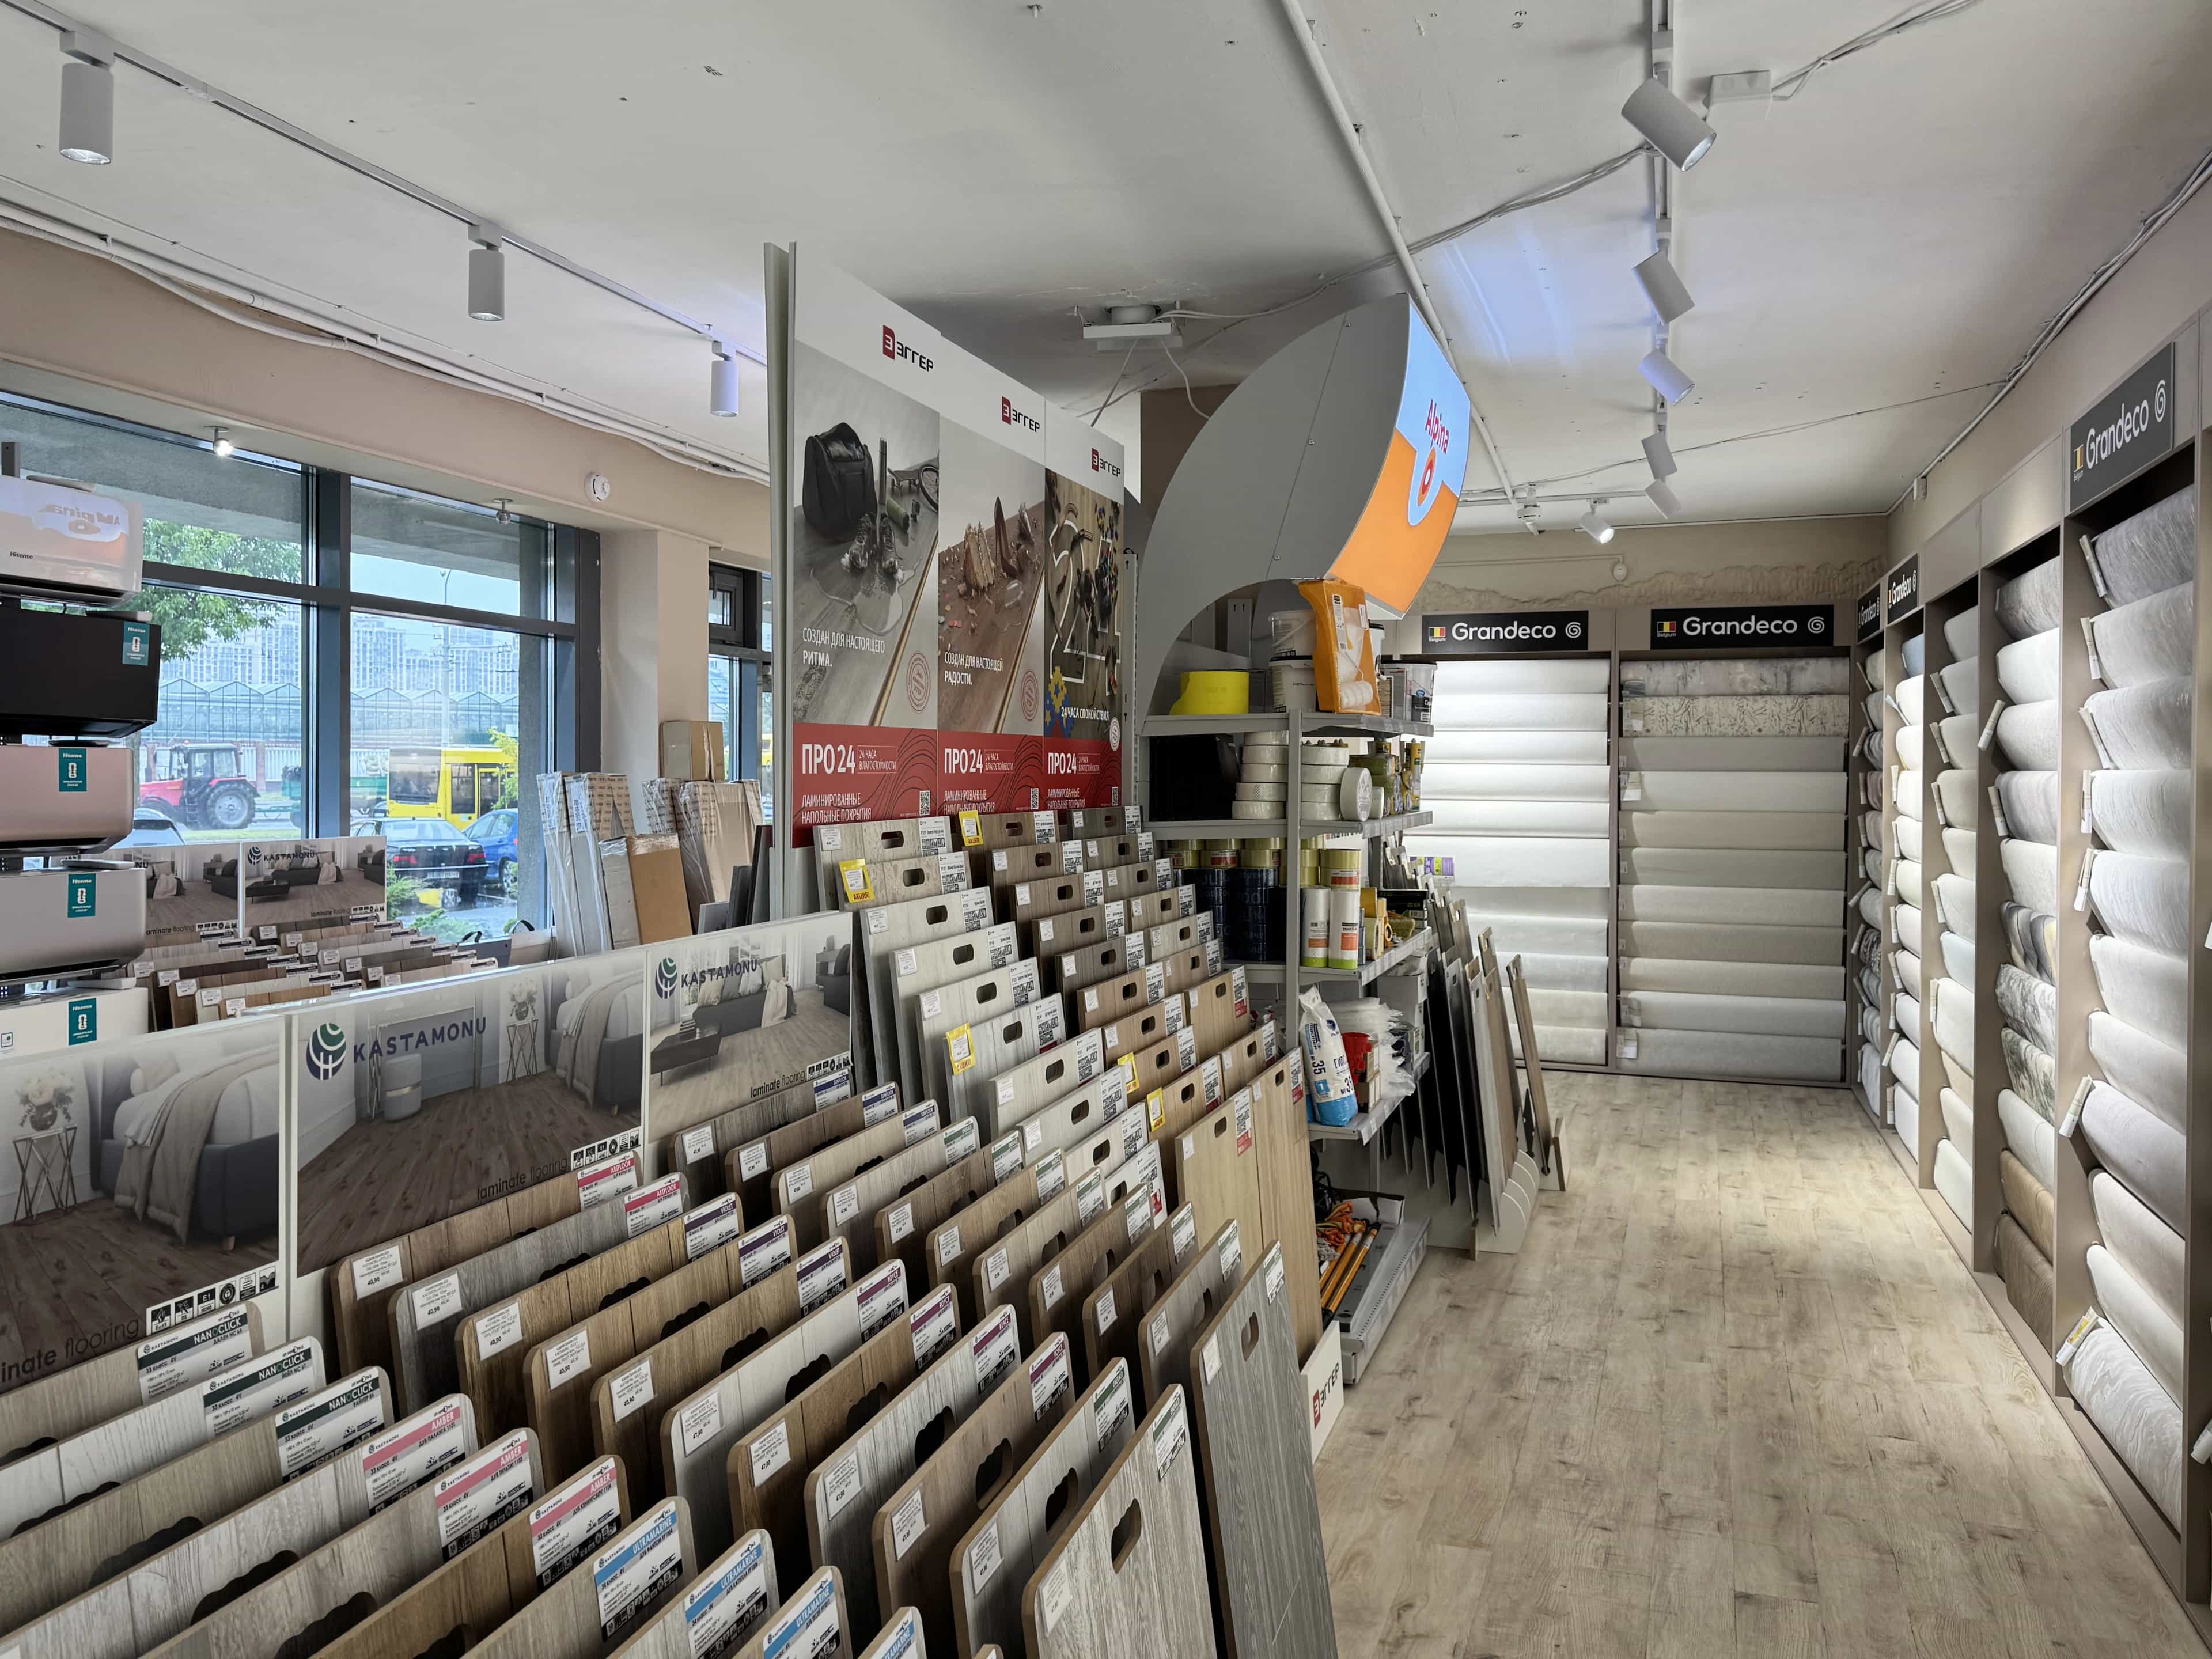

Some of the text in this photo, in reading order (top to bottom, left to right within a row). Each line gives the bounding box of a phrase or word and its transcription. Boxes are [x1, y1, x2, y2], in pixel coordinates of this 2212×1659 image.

[897, 340, 933, 372] ЭГГЕР
[1012, 408, 1040, 433] ЭГГЕР
[1425, 399, 1449, 454] Alpina
[2086, 399, 2149, 469] Grandeco
[1100, 458, 1120, 478] ЭГГЕР
[10, 551, 33, 560] Hisense
[1892, 574, 1912, 605] Grandeco
[1452, 620, 1556, 641] Grandeco
[1683, 615, 1798, 635] Grandeco
[802, 627, 885, 654] СОЗДАН ДЛЯ НАСТОЯЩЕГО
[803, 650, 832, 667] РИТМА.
[945, 652, 1003, 673] СОЗДАН ДЛЯ НАСТОЯЩЕЙ
[945, 671, 973, 685] РАДОСТИ.
[1067, 707, 1079, 718] ЧАСА
[859, 750, 876, 759] 24 ЧАСА
[859, 759, 896, 770] ВЛАГОСТОЙКОСТИ
[801, 793, 861, 807] ЛАМИНИРОВАННЫЕ
[802, 808, 872, 824] НАПОЛЬНЫЕ ПОКРЫТИЯ
[264, 851, 315, 862] KASTAMONU
[146, 927, 171, 935] aminate
[681, 959, 757, 988] KASTAMONU
[354, 1017, 487, 1063] KASTAMONU
[751, 1070, 805, 1098] laminate flooring
[477, 1157, 567, 1201] laminate flooring
[368, 1277, 380, 1285] 40,90
[427, 1306, 440, 1315] 40,90
[194, 1317, 242, 1345] NANOCLICK
[490, 1336, 502, 1346] 40,90
[1, 1319, 139, 1381] inate flooring
[259, 1352, 305, 1381] NANOCLICK
[559, 1365, 570, 1374] 40,90
[329, 1381, 373, 1411] NANOCLICK
[624, 1396, 635, 1406] 40,90
[432, 1412, 454, 1431] AMBER
[501, 1446, 521, 1466] AMBER
[590, 1473, 610, 1493] AMBER
[633, 1517, 672, 1554] ULTRAMARINE
[720, 1550, 757, 1588] ULTRAMARINE
[796, 1586, 830, 1628] ULTRAMARINE
